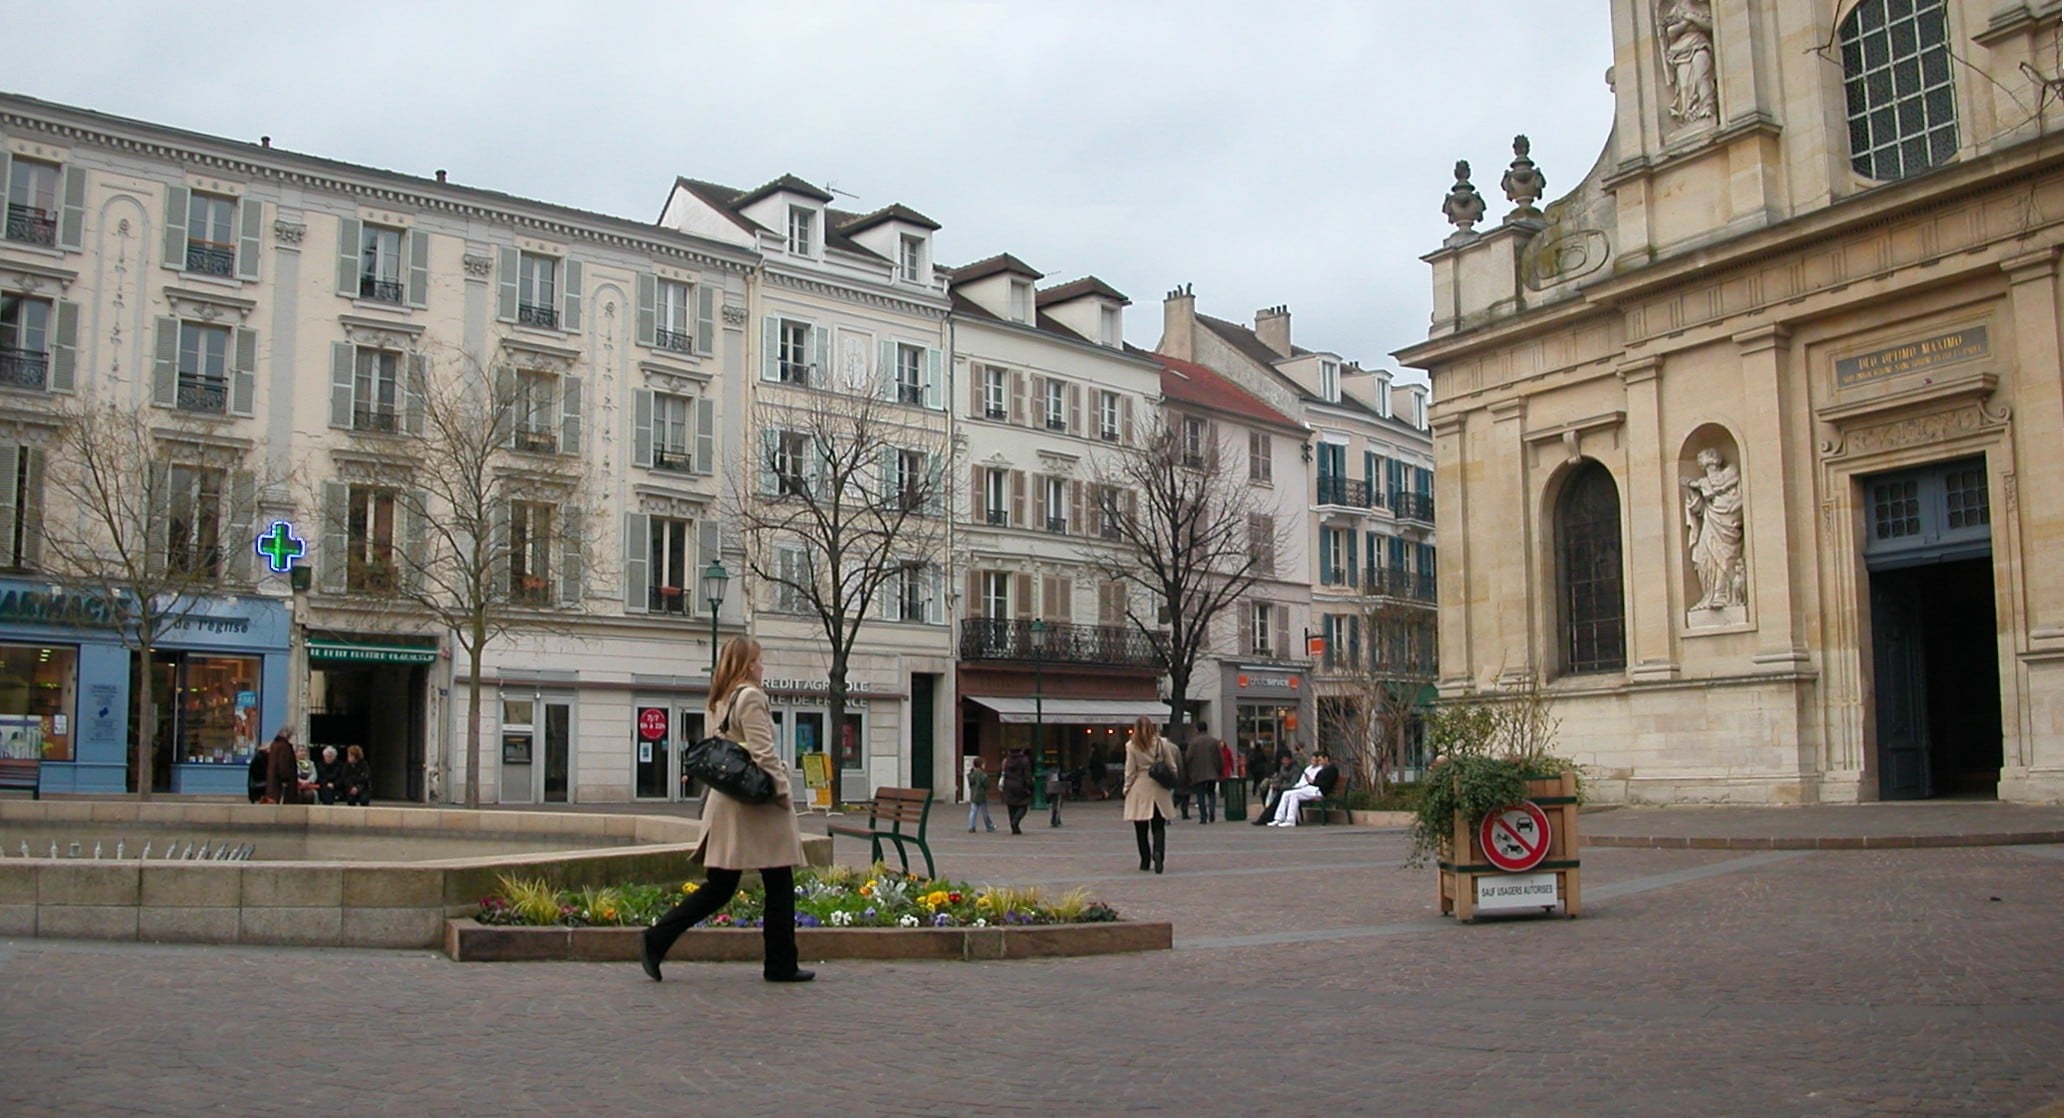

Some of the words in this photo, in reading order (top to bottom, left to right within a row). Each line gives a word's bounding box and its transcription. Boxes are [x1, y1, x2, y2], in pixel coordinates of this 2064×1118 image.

[1882, 347, 1917, 364] OPTIMO
[1921, 335, 1962, 354] MAXIMO
[761, 678, 800, 689] REDIT
[792, 695, 809, 706] DE
[816, 696, 868, 708] FRNCE
[1482, 887, 1496, 897] SAUF
[1497, 885, 1523, 896] USAGERS
